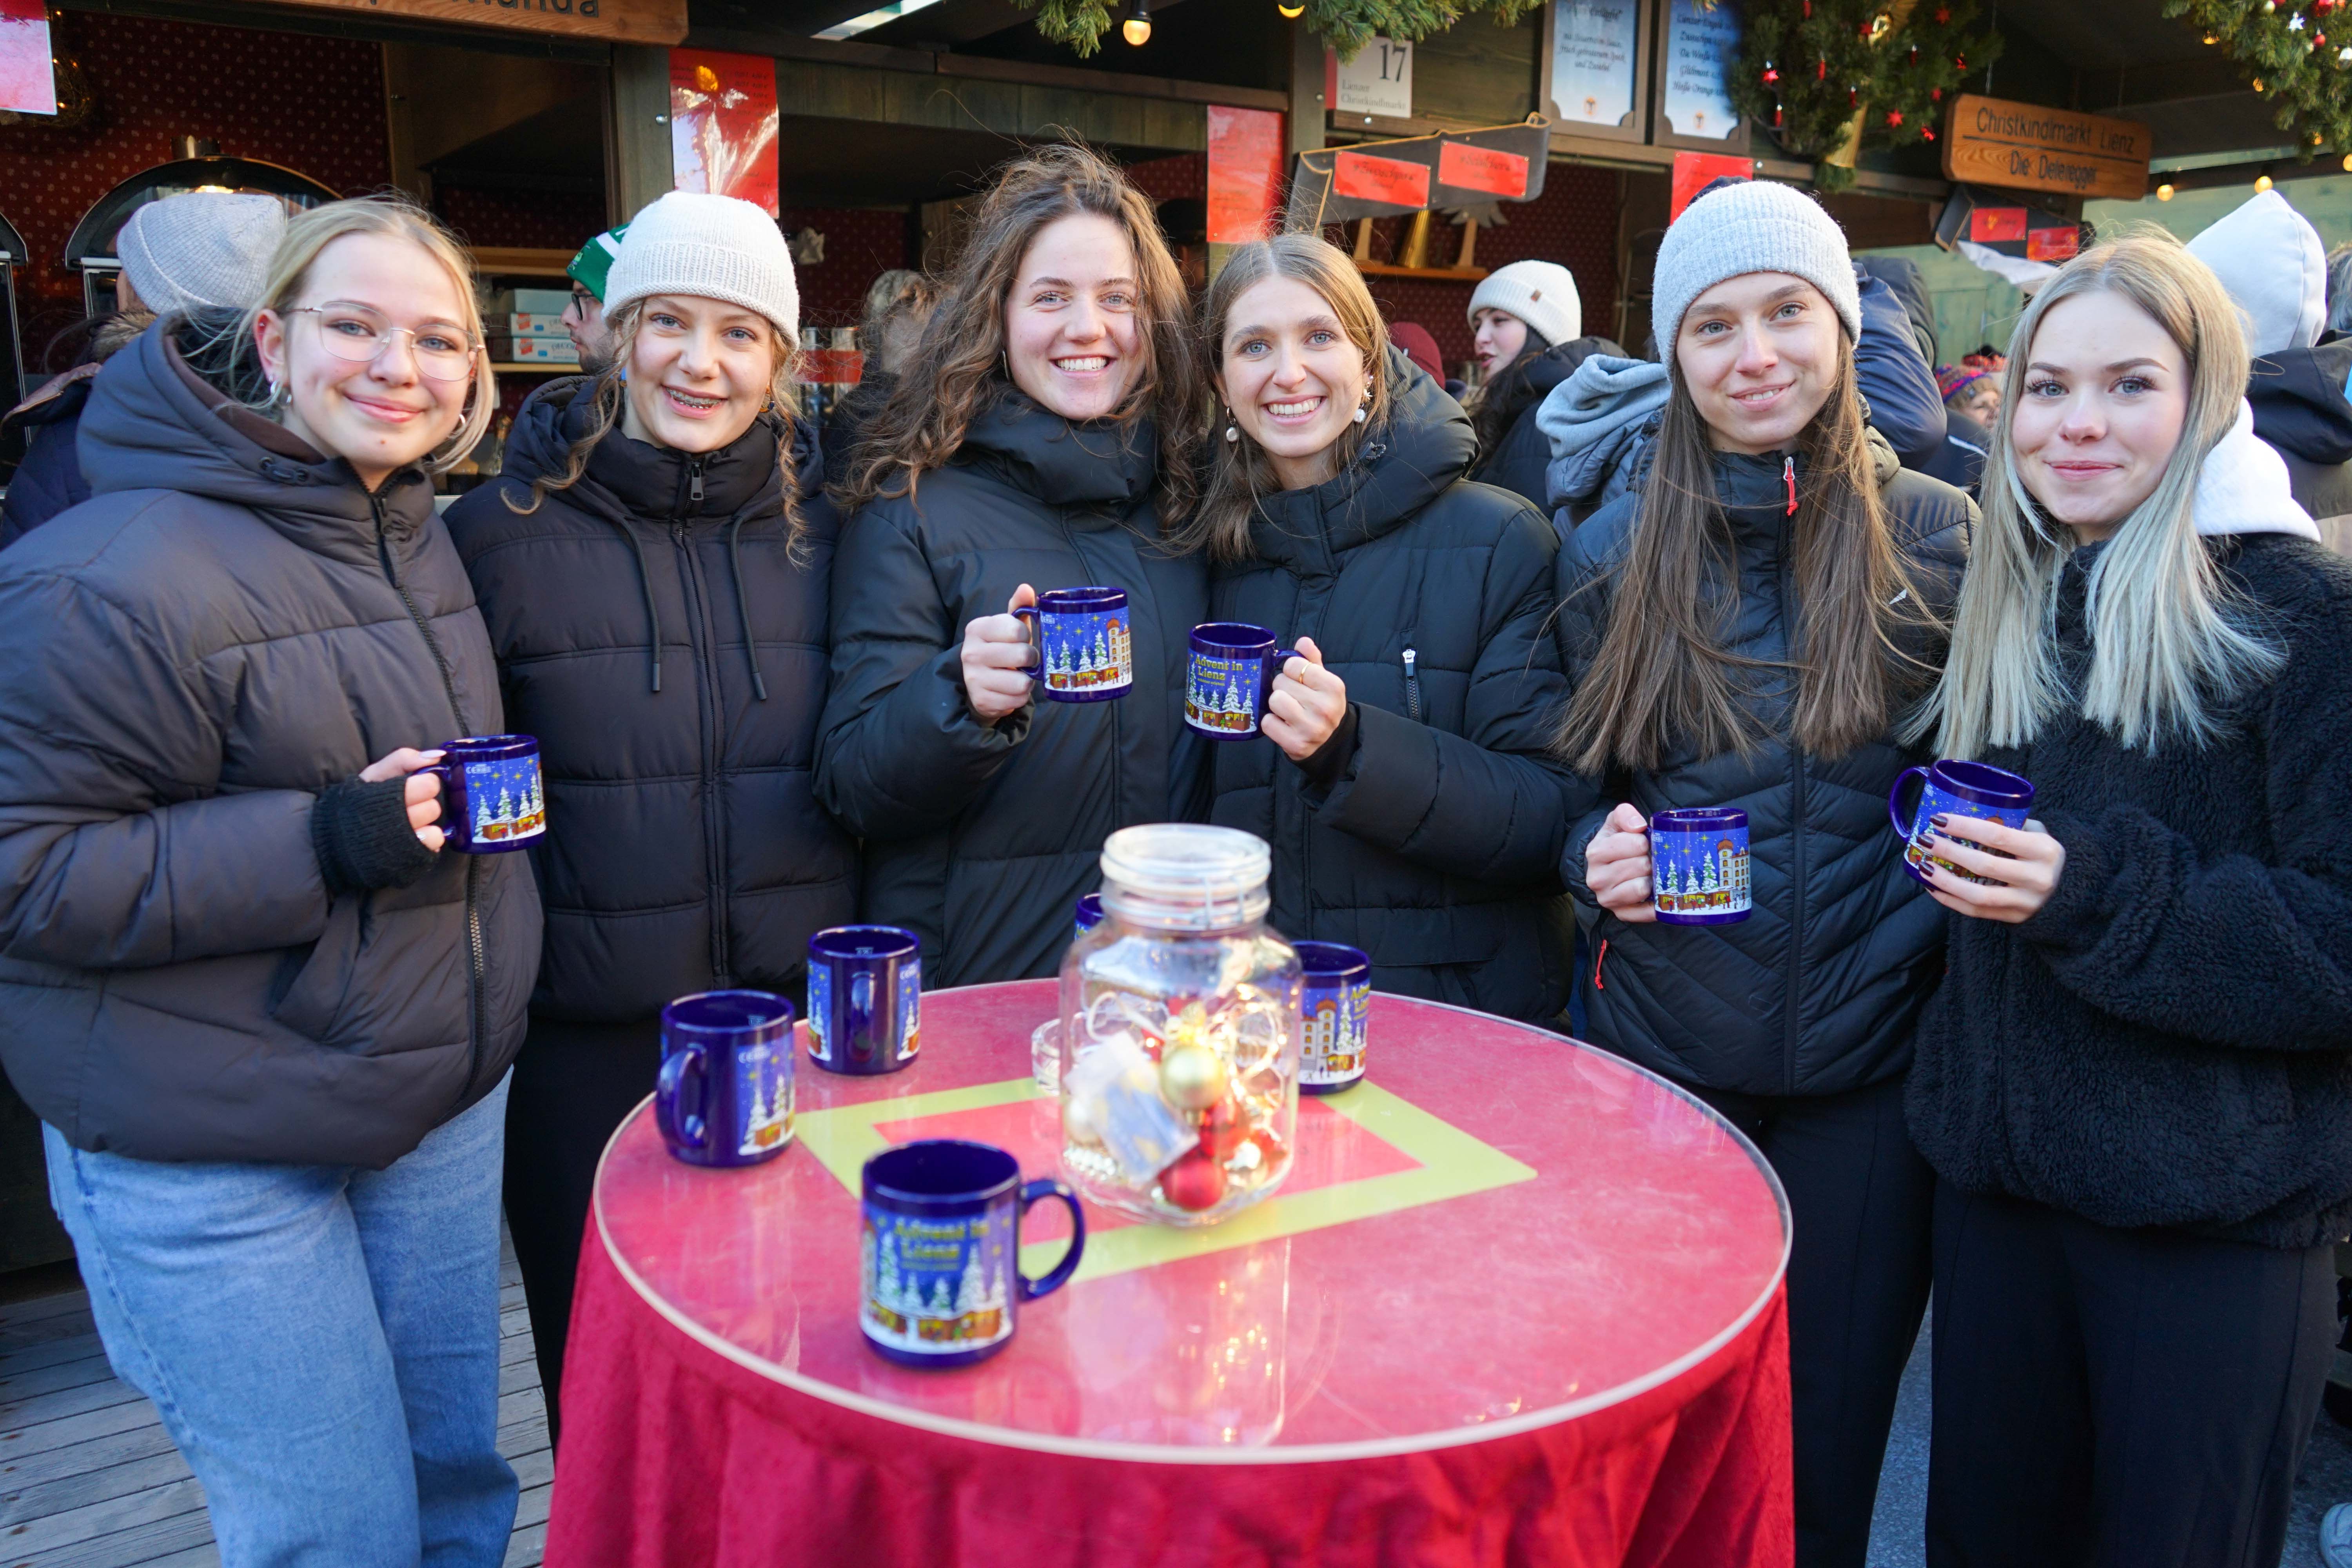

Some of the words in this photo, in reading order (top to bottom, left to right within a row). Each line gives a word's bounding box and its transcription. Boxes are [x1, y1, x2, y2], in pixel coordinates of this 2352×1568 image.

[1379, 44, 1407, 83] 17
[1976, 106, 2092, 145] Christkindlmarkt
[2100, 123, 2135, 154] Lienz
[2009, 149, 2030, 176] Die
[1195, 654, 1230, 670] Advent
[1231, 661, 1243, 671] in
[1198, 666, 1226, 680] Lienz
